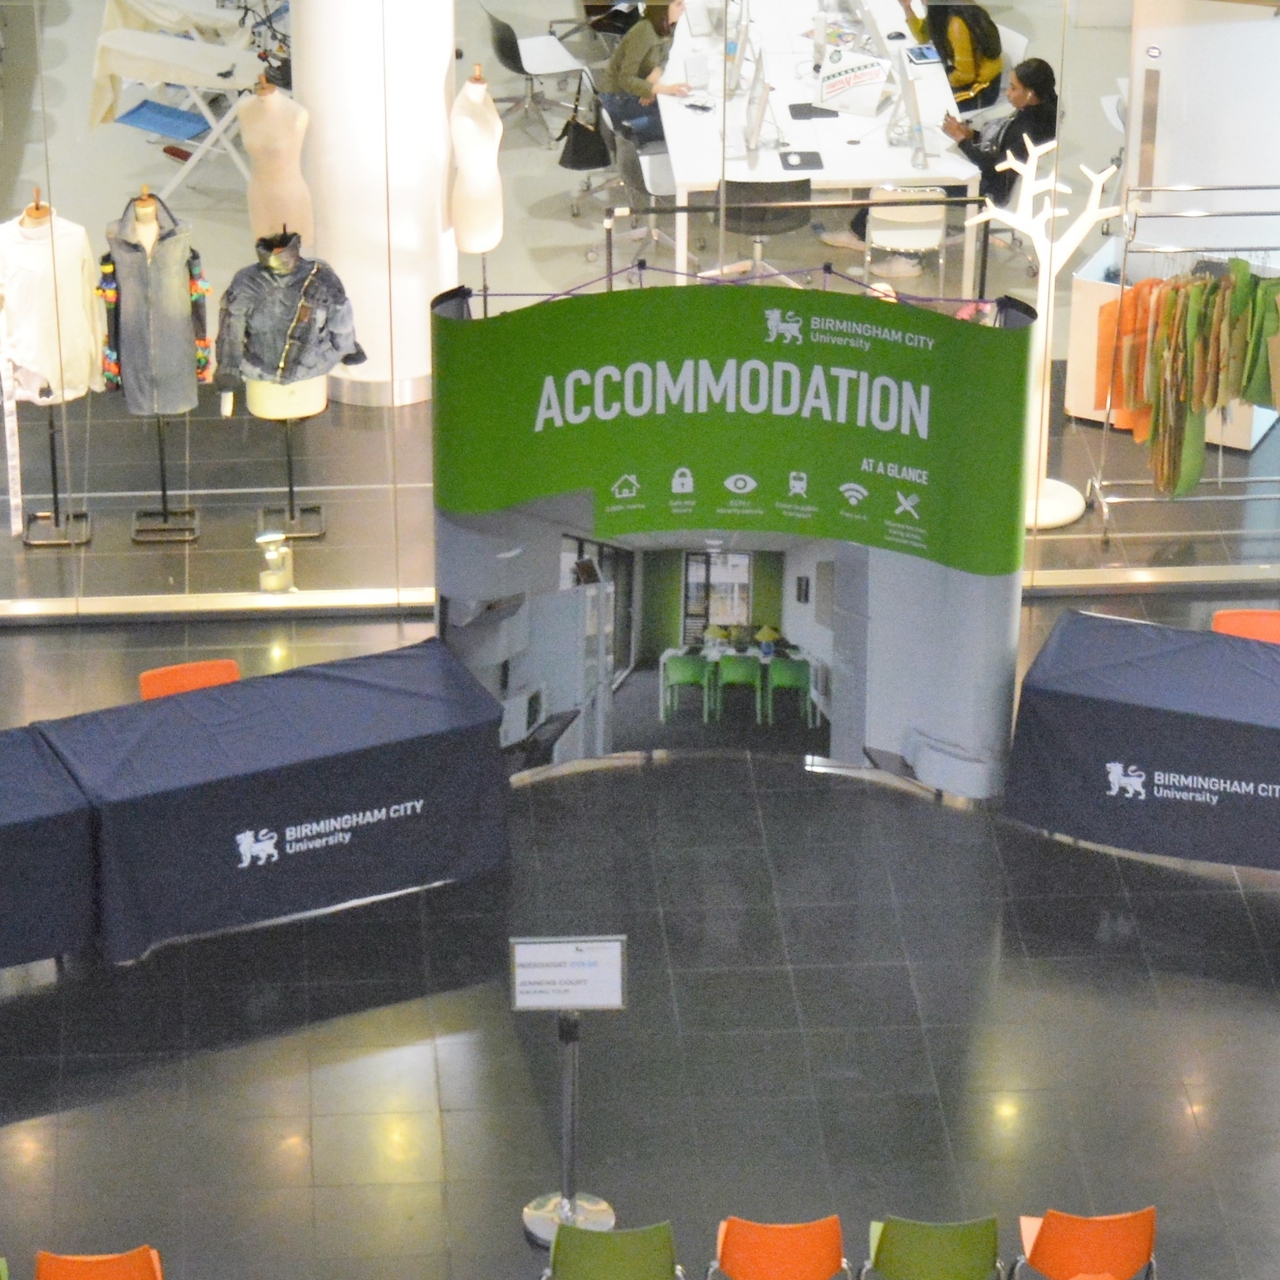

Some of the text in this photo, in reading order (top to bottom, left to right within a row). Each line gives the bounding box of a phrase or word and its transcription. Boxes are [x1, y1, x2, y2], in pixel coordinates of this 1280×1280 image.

[810, 316, 935, 350] BIRMINGHAM CITY
[810, 332, 871, 351] University
[534, 358, 931, 440] ACCOMMODATION
[861, 457, 929, 485] AT A GLANCE
[1153, 786, 1219, 805] University
[1154, 771, 1255, 795] BIRMINGHAM
[285, 799, 424, 841] BIRMINGHAM CITY
[286, 831, 352, 854] University
